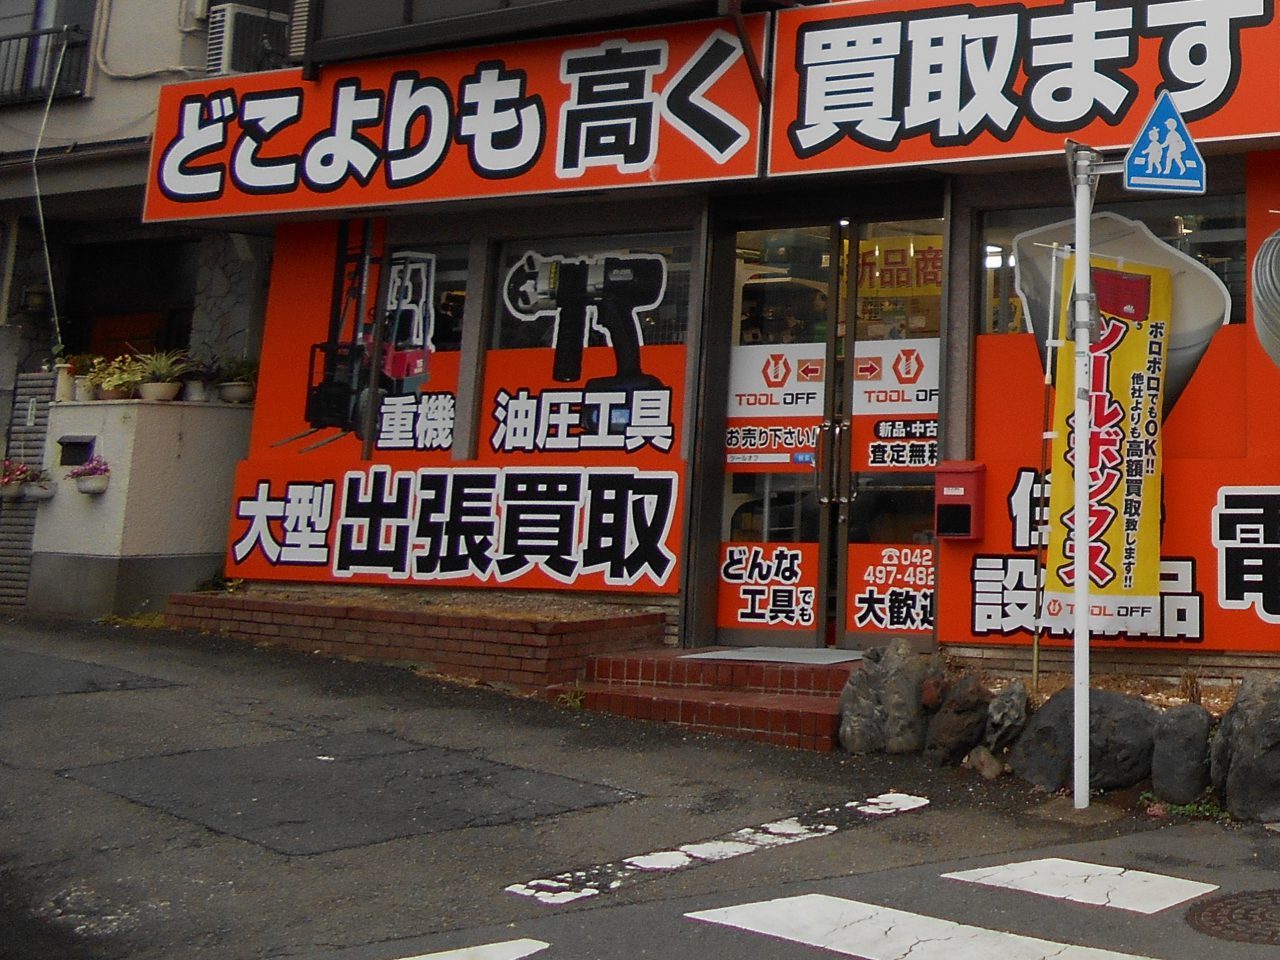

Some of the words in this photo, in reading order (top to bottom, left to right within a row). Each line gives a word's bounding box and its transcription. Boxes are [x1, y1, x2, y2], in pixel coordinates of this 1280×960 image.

[157, 28, 749, 201] どこよりも高く
[735, 393, 780, 406] TOOL
[783, 392, 817, 405] OFF
[864, 390, 912, 403] TOOL
[376, 393, 456, 450] 重機
[491, 389, 675, 451] 油圧工具
[234, 464, 678, 586] 大型出張買取
[721, 547, 801, 583] どんな
[901, 548, 932, 565] 042
[972, 555, 1203, 640] 設品
[1066, 603, 1113, 617] TOL
[1117, 605, 1152, 617] OFF
